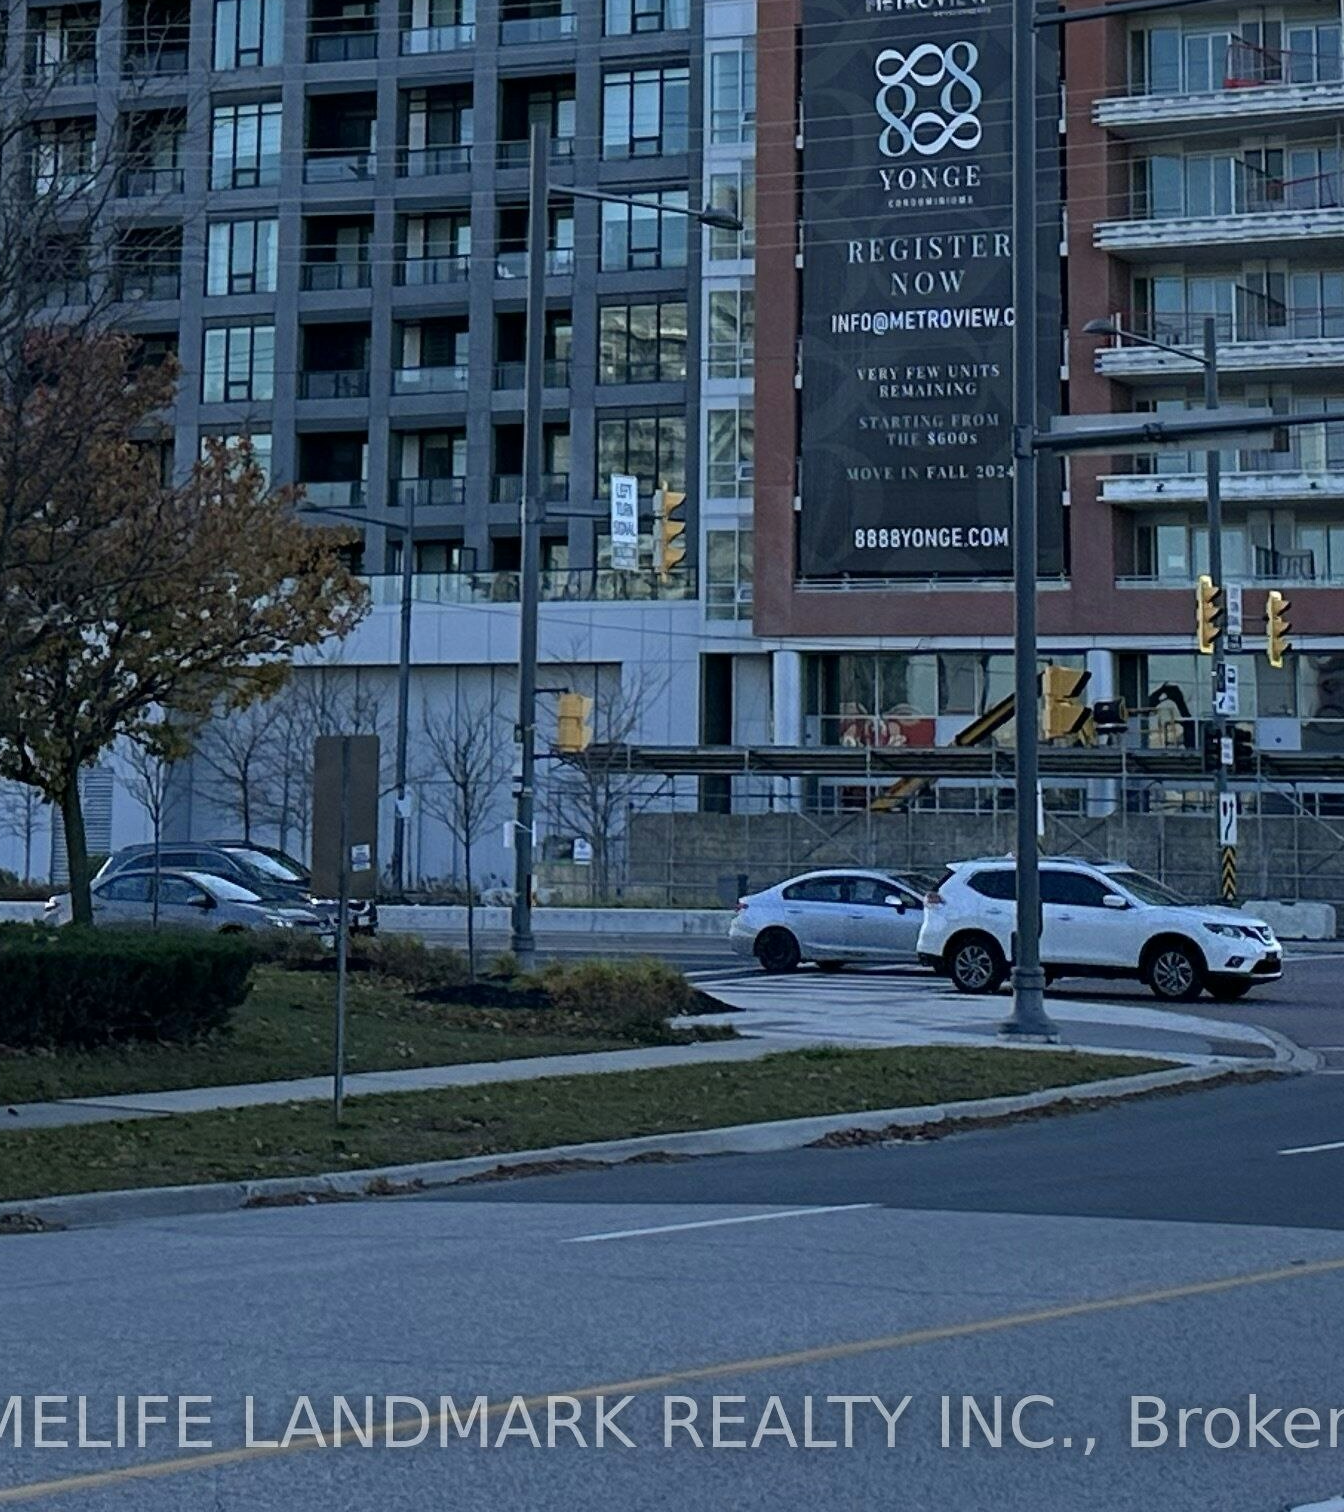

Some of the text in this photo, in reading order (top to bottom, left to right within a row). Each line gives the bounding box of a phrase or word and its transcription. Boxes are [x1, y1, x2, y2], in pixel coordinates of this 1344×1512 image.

[879, 165, 981, 191] YONGE
[847, 233, 1012, 264] REGISTER
[891, 270, 966, 296] NOW
[831, 307, 1016, 335] INFO@METROVIEW.C
[856, 364, 1001, 381] VERY FEW UNITS
[879, 383, 977, 399] REMAINING
[859, 413, 999, 430] STARTING FROM
[887, 432, 921, 446] THE
[846, 465, 1015, 481] MOVE IN FALL 2024
[855, 527, 1009, 549] 8888YONGE.COM
